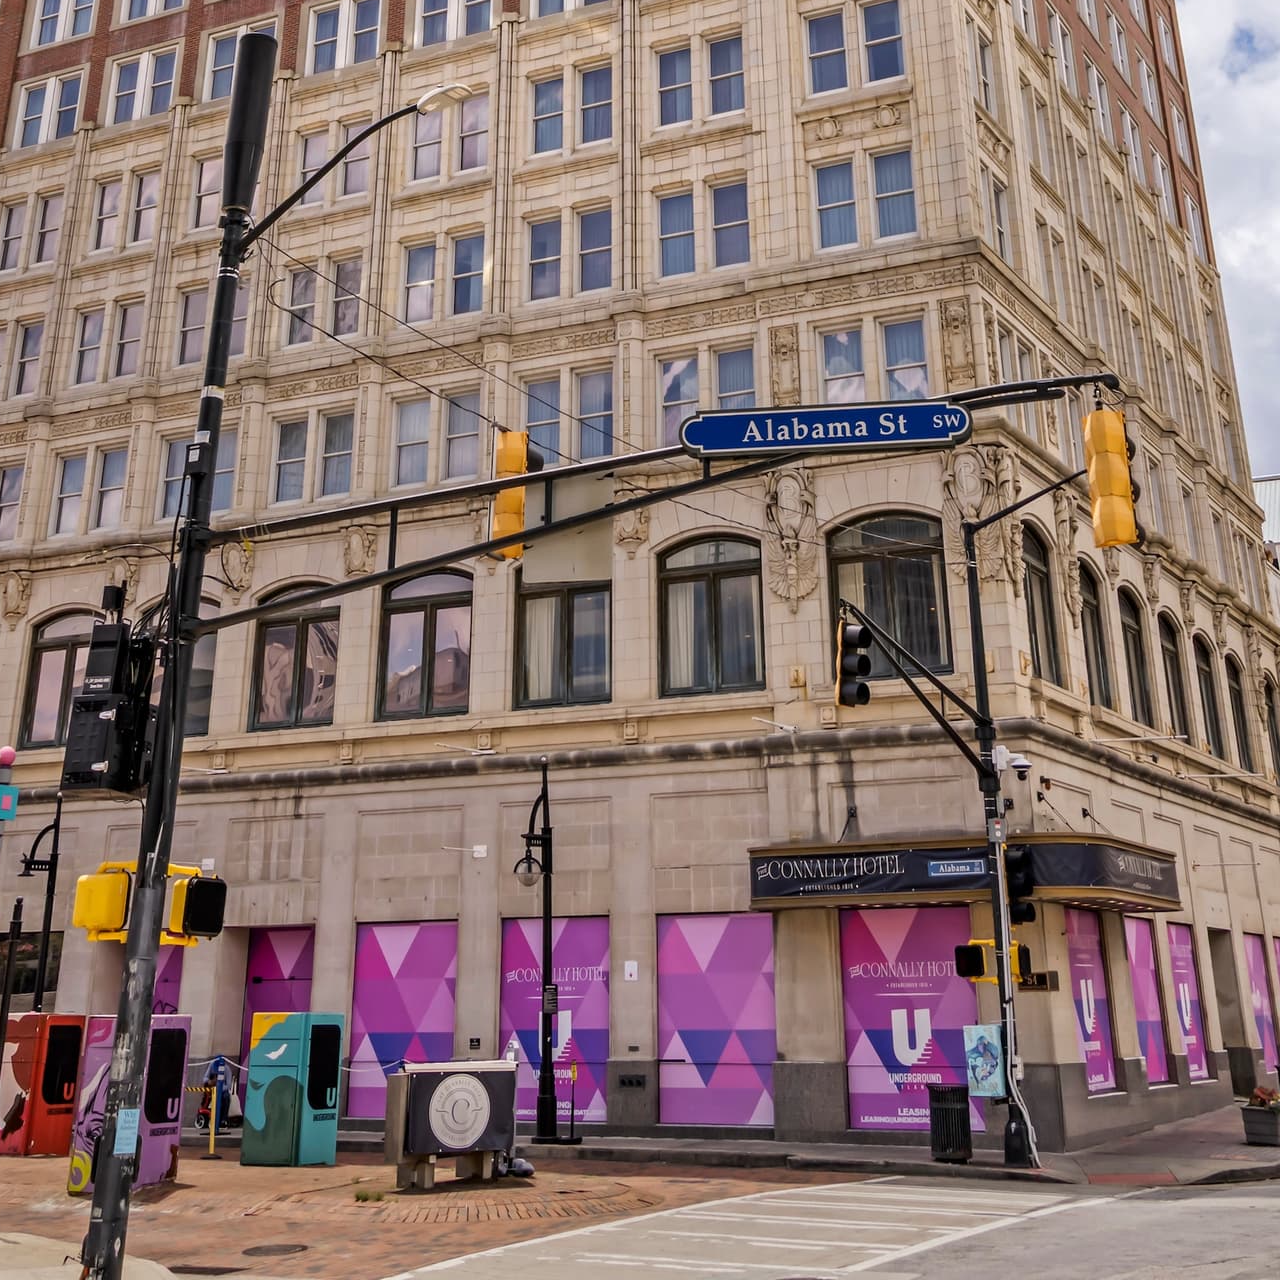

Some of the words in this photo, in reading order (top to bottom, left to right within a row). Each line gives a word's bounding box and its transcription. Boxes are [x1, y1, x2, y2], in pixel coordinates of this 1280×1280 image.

[742, 418, 869, 443] Alabama
[879, 413, 908, 435] St
[932, 413, 961, 429] SW
[767, 858, 850, 880] CONNALLY
[854, 855, 904, 875] HOTEL
[940, 864, 970, 873] Alabama
[516, 967, 570, 983] CONLLY
[572, 966, 607, 981] HOTEL
[860, 961, 925, 978] CONNALLY
[891, 1008, 933, 1067] U
[889, 1073, 942, 1084] UNDERGROUND
[63, 1082, 74, 1100] U
[326, 1087, 336, 1107] U
[167, 1098, 179, 1119] U
[898, 1108, 930, 1116] LEASIN
